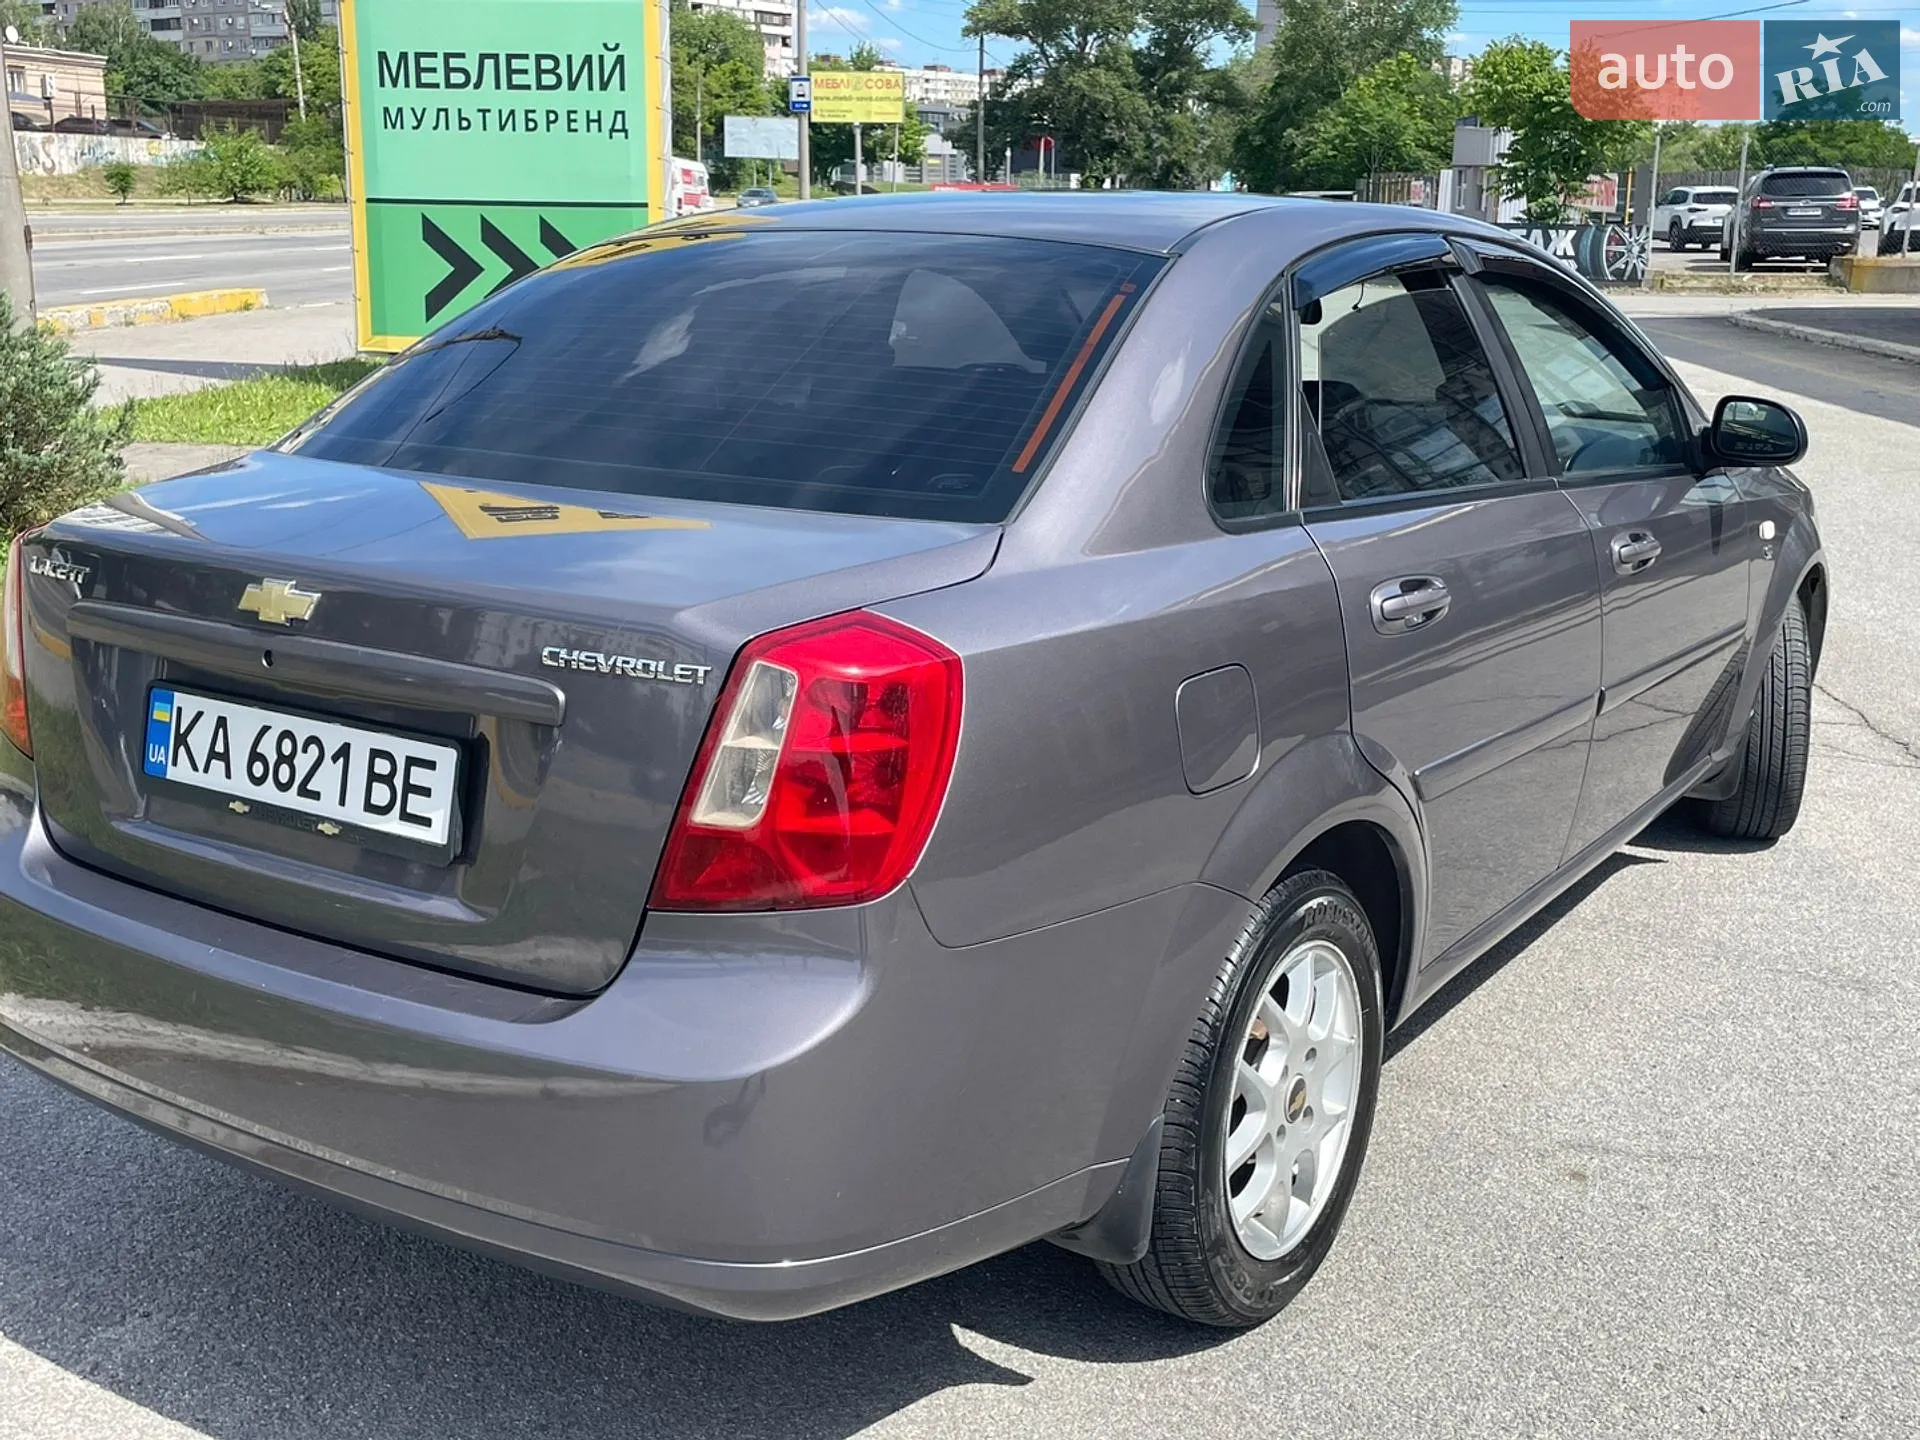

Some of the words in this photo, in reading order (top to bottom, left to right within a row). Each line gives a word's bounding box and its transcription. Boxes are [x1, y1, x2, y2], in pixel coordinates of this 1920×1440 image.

[377, 43, 626, 91] МЕБЛЕВИЙ
[864, 78, 902, 89] СОВА
[382, 106, 629, 140] МУЛЬТИБРЕНД
[541, 646, 713, 685] CHEVROLET
[149, 743, 166, 765] UA
[171, 706, 231, 780] KA
[246, 725, 351, 807] 6821
[363, 747, 437, 829] BE
